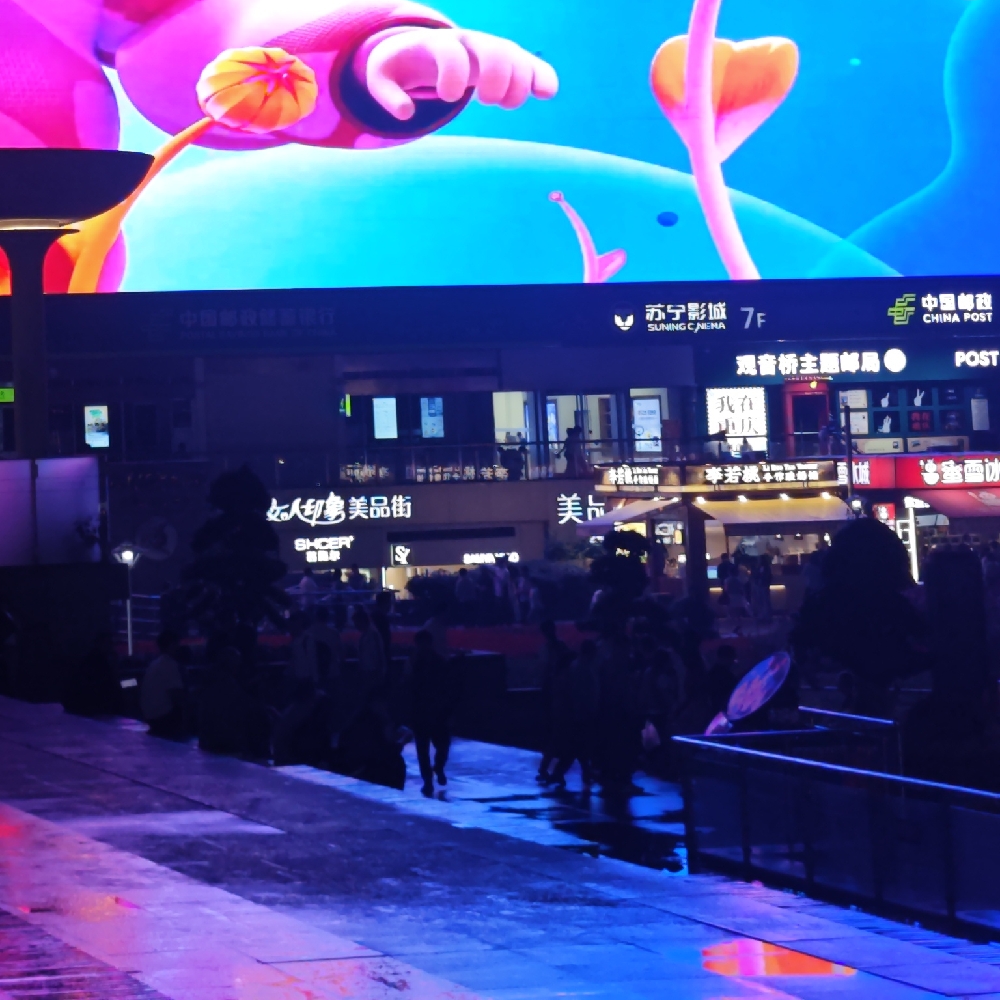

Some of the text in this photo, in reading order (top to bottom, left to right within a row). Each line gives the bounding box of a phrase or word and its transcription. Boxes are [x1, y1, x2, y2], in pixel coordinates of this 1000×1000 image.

[645, 301, 728, 321] 苏宁影城
[921, 292, 993, 312] 中国邮政
[647, 322, 687, 332] SUNING
[922, 312, 993, 324] CHINA POST
[736, 352, 881, 376] 观音桥主题邮局
[954, 350, 1000, 368] POST
